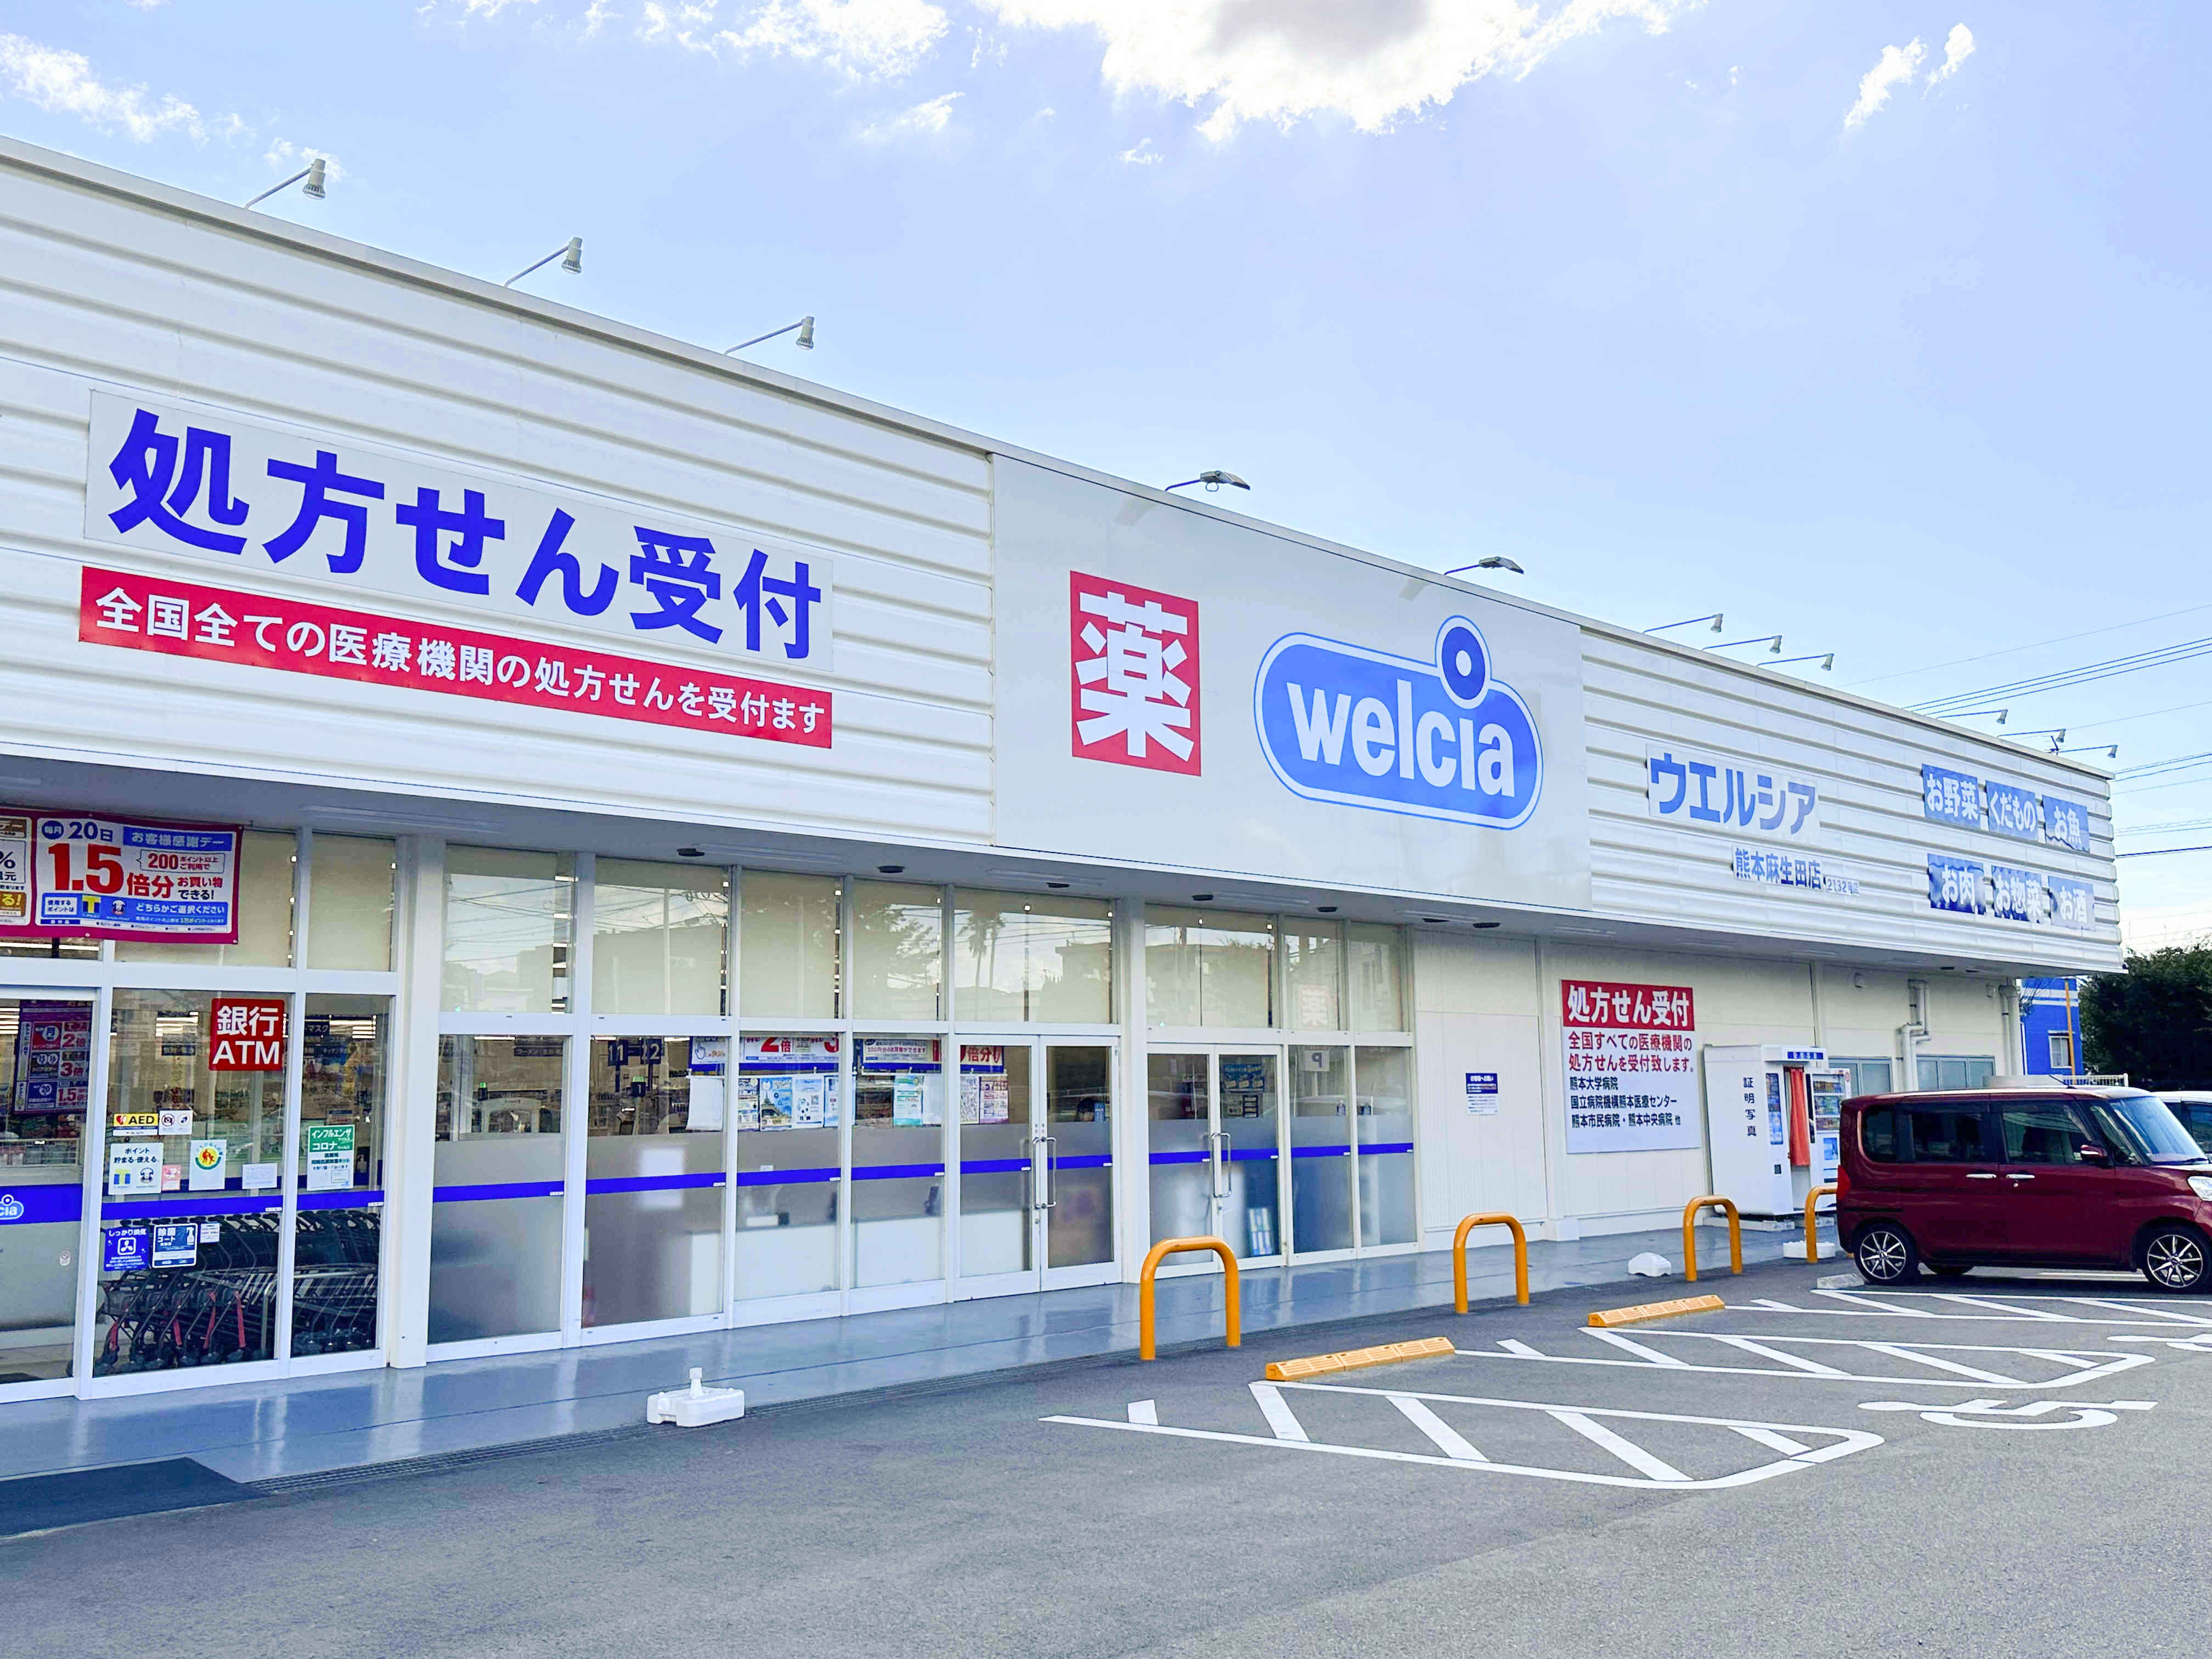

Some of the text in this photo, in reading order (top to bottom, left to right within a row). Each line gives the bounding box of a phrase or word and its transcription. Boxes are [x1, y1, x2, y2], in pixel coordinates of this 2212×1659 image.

[108, 408, 822, 658] 処方せん受付
[95, 588, 825, 732] 全国全ての医療機関の処方せんを受付ます
[1075, 591, 1194, 761] 薬
[1286, 627, 1515, 797] welcia
[1650, 752, 1816, 834] ウエルシア
[1926, 773, 1980, 820] お野菜
[1990, 791, 2036, 833] くだもの
[2055, 805, 2082, 845] お魚
[67, 821, 114, 842] 20日
[131, 832, 224, 848] お客様感謝デー
[148, 853, 178, 870] 200
[1735, 847, 1821, 890] 熊本麻生田店
[0, 871, 17, 881] 元
[177, 877, 223, 888] お買い物
[1942, 865, 1976, 907] お肉
[178, 890, 215, 900] できる!
[2059, 885, 2088, 923] お酒
[1567, 985, 1689, 1027] 処方せん受付
[217, 1006, 279, 1036] 銀行
[212, 1040, 280, 1064] ATM
[1568, 1031, 1692, 1052] 全国すべての医療機関の
[1568, 1053, 1694, 1073] 処方せんを受付致します。
[1570, 1076, 1618, 1091] 熊本大学病院
[1571, 1094, 1677, 1109] 国立病院機構熊本医療センター
[1743, 1077, 1757, 1137] 証明写真
[128, 1115, 155, 1125] AED
[311, 1128, 352, 1140] インフルエンザ
[312, 1141, 338, 1150] コロナ
